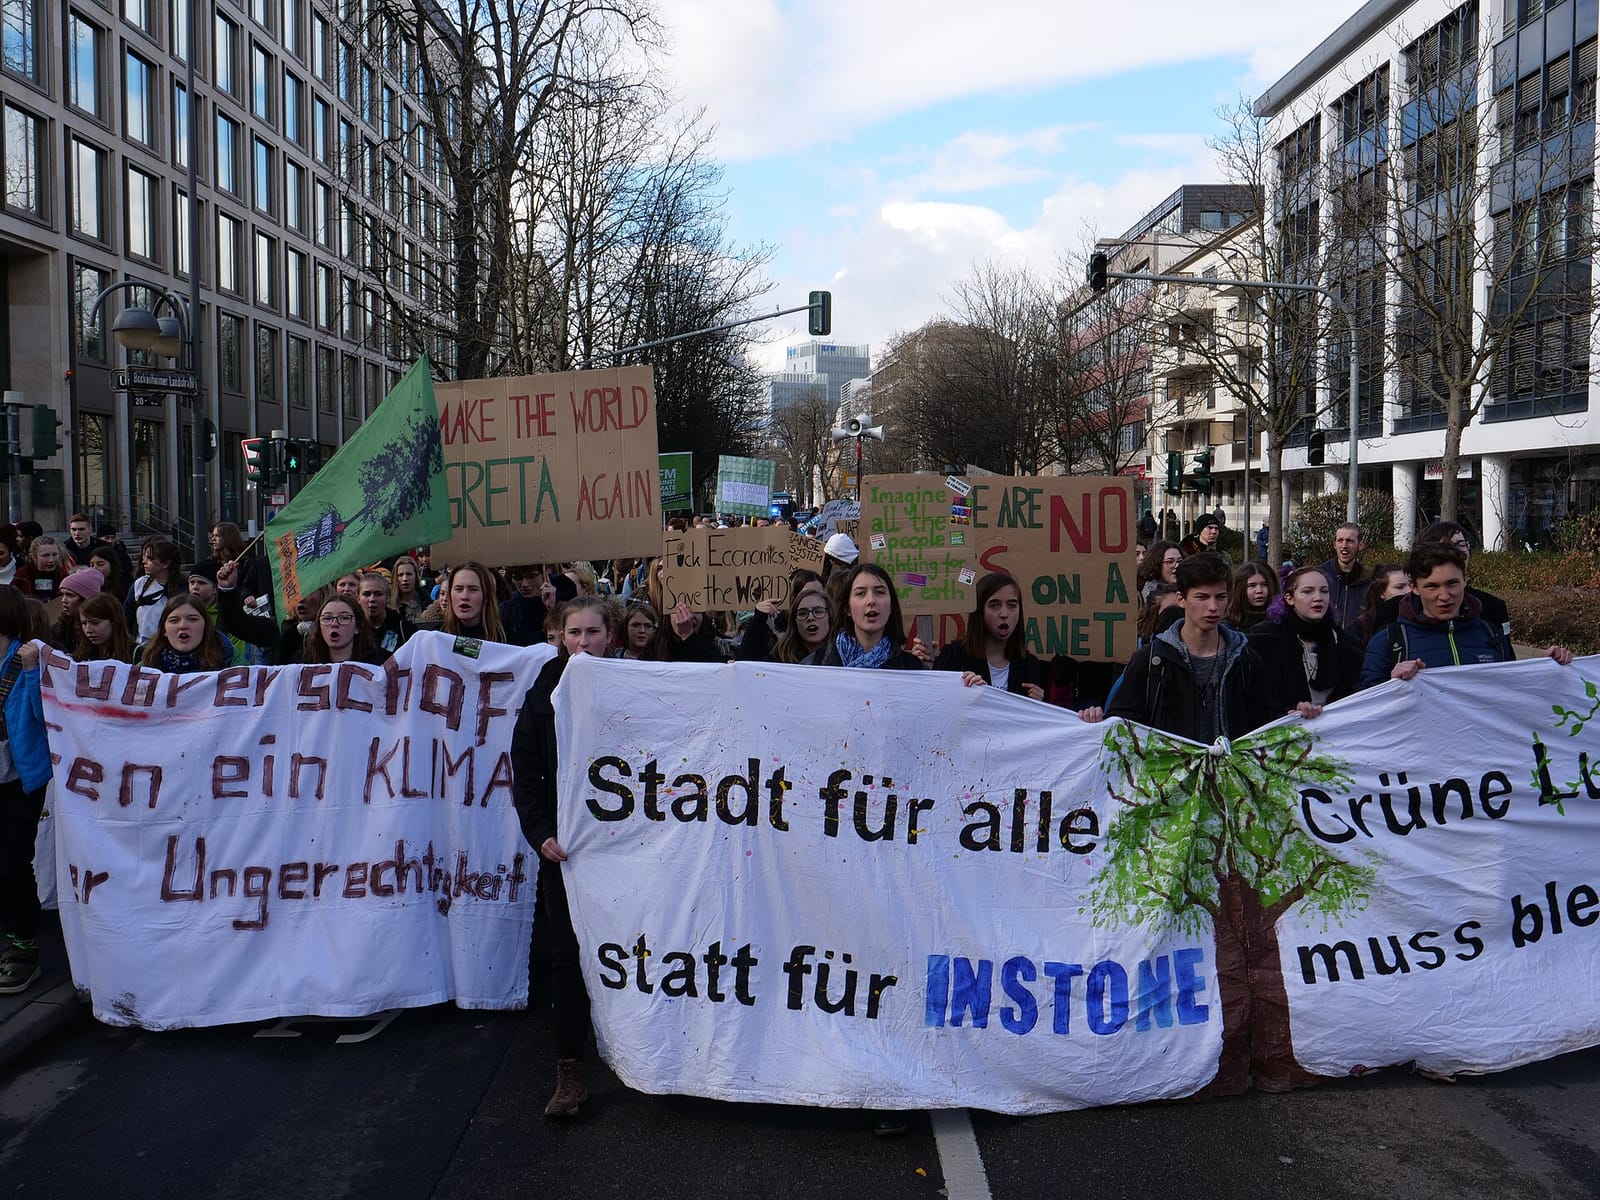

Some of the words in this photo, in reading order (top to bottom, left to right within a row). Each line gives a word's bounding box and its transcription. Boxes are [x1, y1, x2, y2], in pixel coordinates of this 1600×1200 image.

[509, 393, 557, 439] THE
[570, 385, 649, 434] WORLD
[447, 455, 560, 528] GRETA
[576, 468, 653, 522] AGAIN
[870, 485, 947, 516] Imagine
[872, 505, 900, 533] all
[910, 504, 947, 533] the
[998, 487, 1044, 528] ARE
[1050, 486, 1128, 553] NO
[789, 545, 822, 563] SYSTEM
[888, 528, 945, 560] people
[942, 552, 965, 577] for
[666, 576, 701, 610] Save
[703, 574, 732, 605] the
[1031, 573, 1081, 605] ON
[1105, 562, 1129, 603] A
[213, 735, 328, 801] ein
[364, 737, 514, 808] KLIMA
[585, 756, 792, 832] Stadt
[819, 770, 934, 845] für
[959, 789, 1099, 854] alle
[1299, 771, 1512, 844] Grüne
[160, 834, 525, 930] Ungerechtigkeit
[1297, 920, 1484, 985] muss
[1511, 880, 1600, 949] ble
[598, 934, 758, 1006] statt
[783, 945, 898, 1019] für
[925, 947, 1209, 1036] INSTONE
